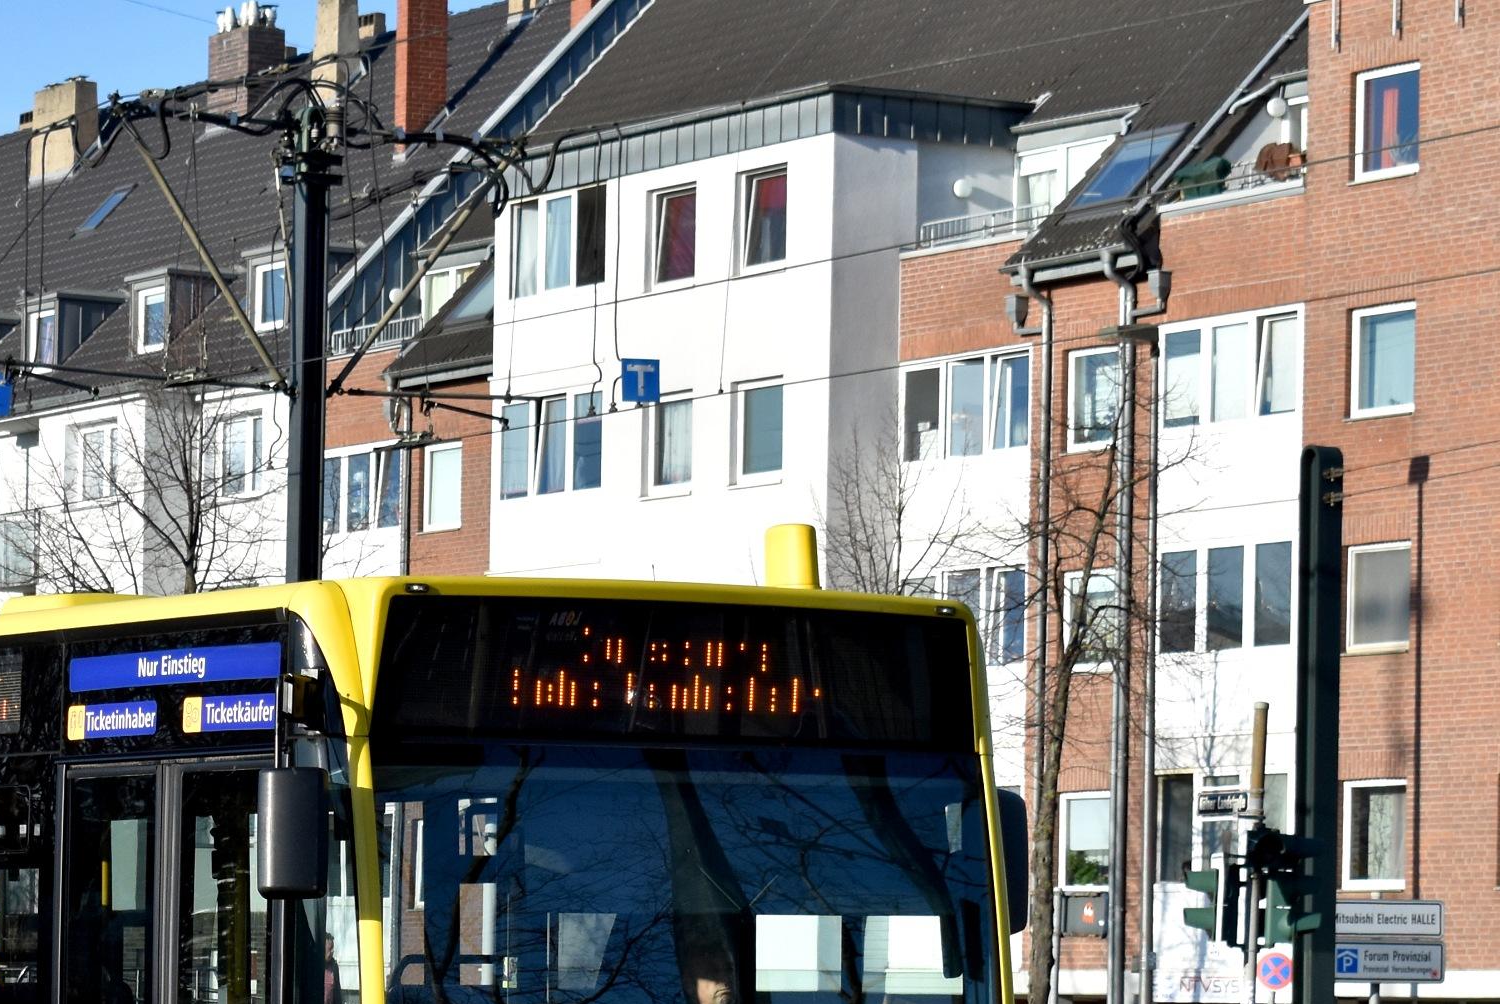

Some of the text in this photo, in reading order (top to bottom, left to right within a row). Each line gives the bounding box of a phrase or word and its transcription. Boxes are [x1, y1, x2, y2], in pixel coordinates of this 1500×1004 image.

[137, 653, 206, 678] Nur Einstieg
[86, 707, 156, 732] Ticketinhaber
[205, 699, 275, 725] Ticketkäufer
[1377, 914, 1407, 925] Electric
[1411, 914, 1436, 925] HALLE
[1364, 951, 1431, 962] Forum Provinzial
